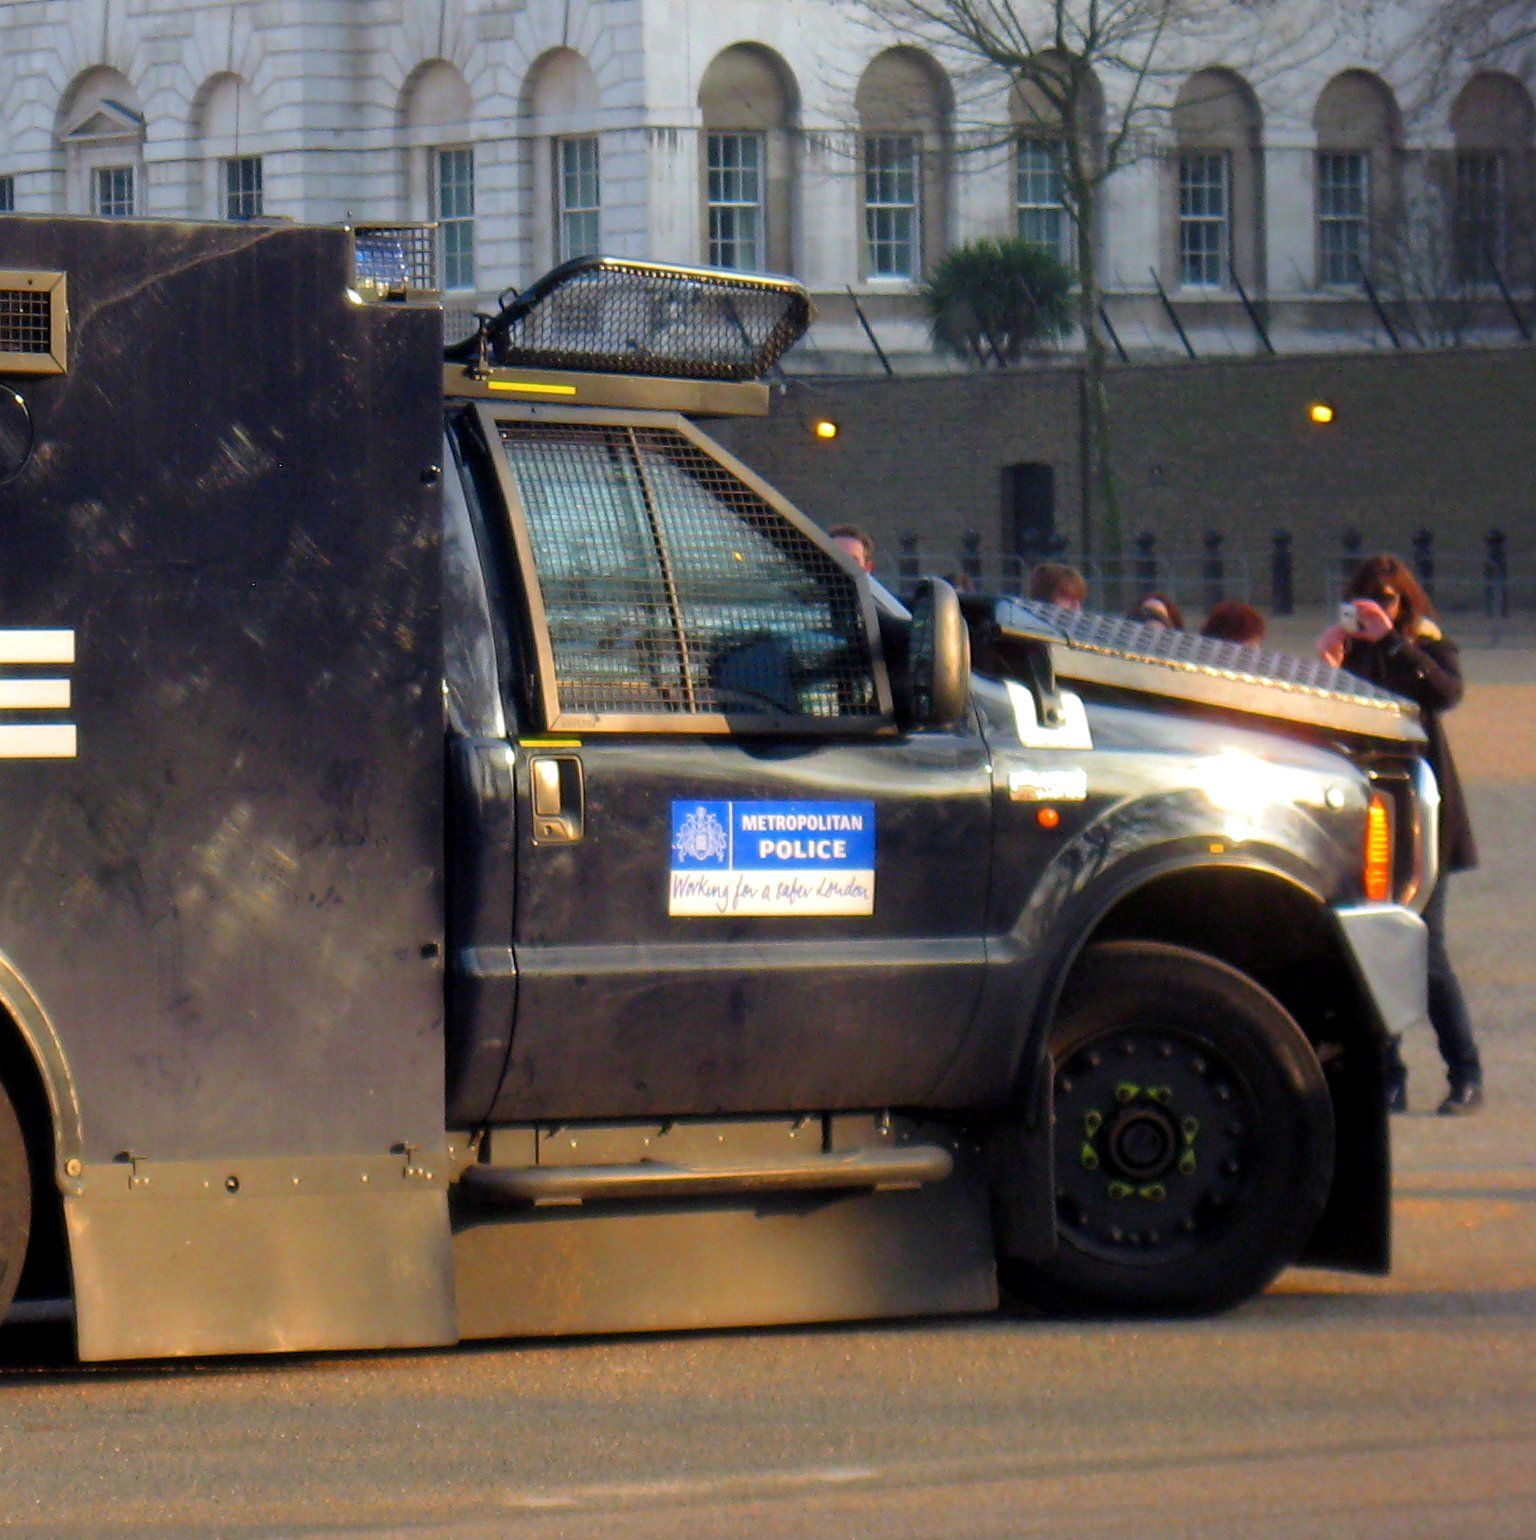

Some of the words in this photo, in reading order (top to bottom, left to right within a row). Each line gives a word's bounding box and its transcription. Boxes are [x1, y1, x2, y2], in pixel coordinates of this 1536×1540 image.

[742, 814, 863, 832] METROPOLITAN
[759, 840, 847, 860] POLICE
[673, 874, 729, 914] Working
[732, 874, 758, 910] for
[762, 885, 771, 901] a
[776, 877, 813, 905] safer
[816, 876, 870, 900] London
